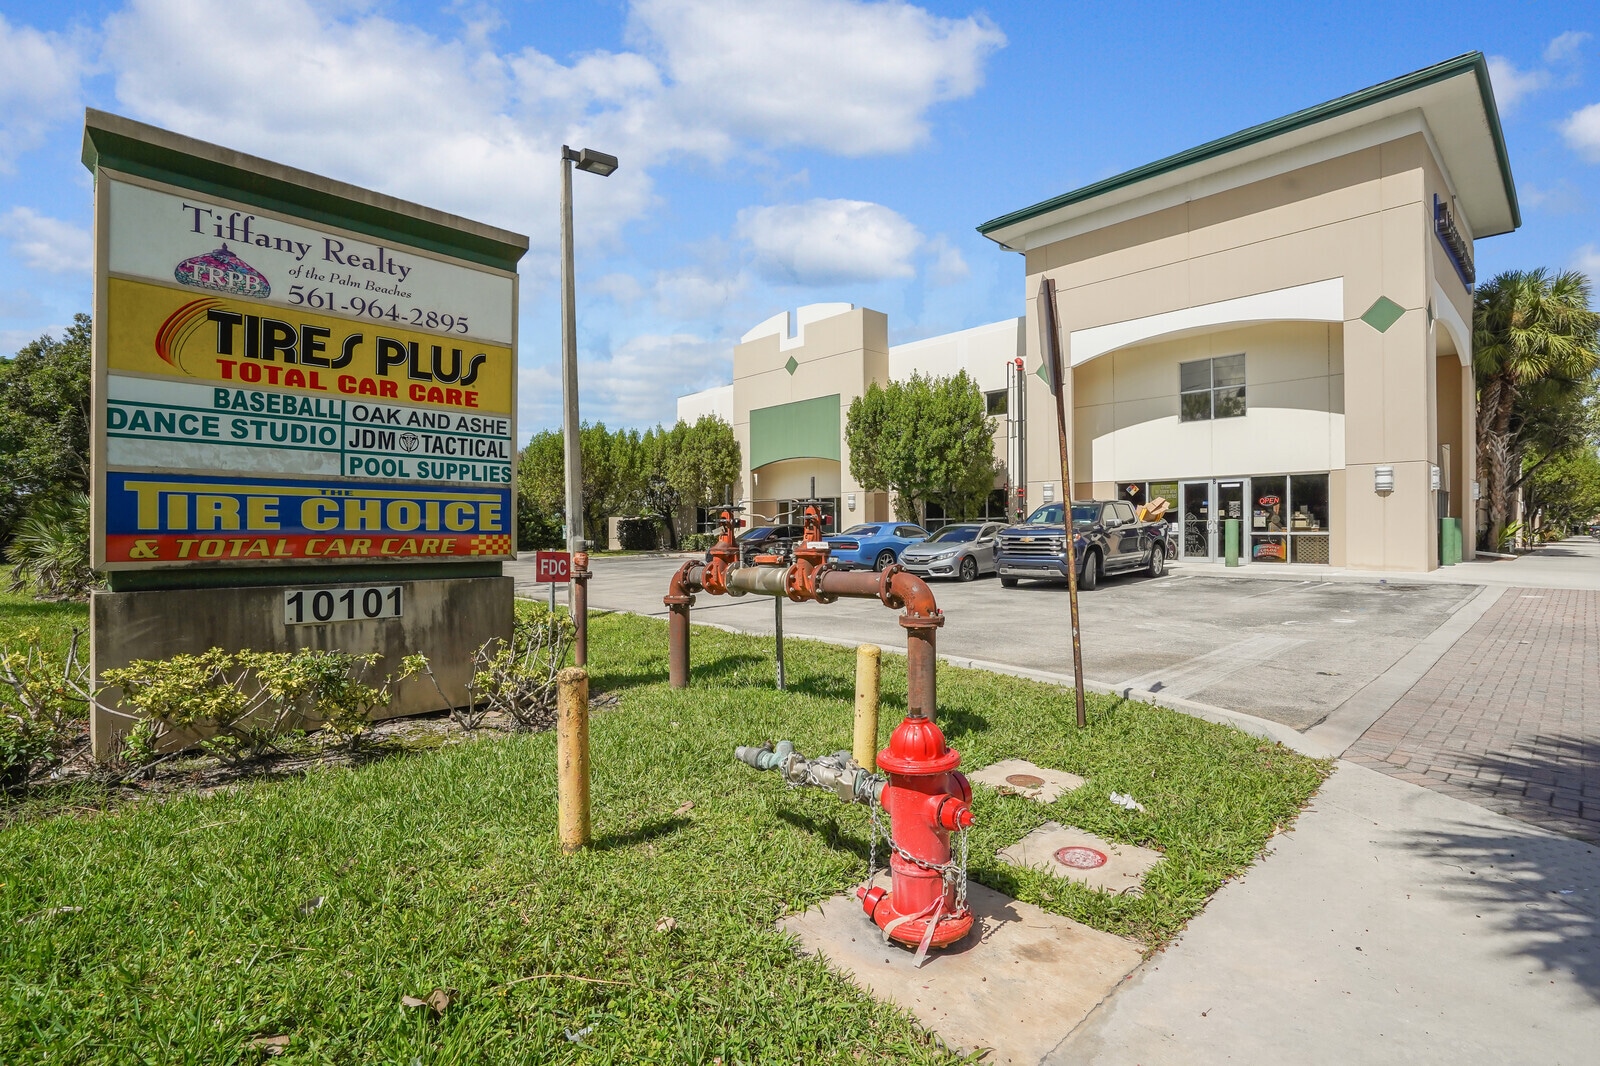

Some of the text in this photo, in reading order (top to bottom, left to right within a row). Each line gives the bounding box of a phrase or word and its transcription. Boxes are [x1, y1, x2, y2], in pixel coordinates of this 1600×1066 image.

[182, 202, 412, 282] Tiffany Realty
[186, 262, 262, 293] TRPB
[288, 265, 412, 299] of the Palm Beaches
[287, 285, 469, 334] 561-964-2895
[207, 308, 486, 386] TIRES PLUS
[216, 358, 479, 408] TOTAL CAR CARE
[213, 387, 341, 420] BASEBALL
[352, 404, 507, 435] OAK AND ASHE
[107, 407, 337, 446] DANCE STUDIO
[349, 428, 508, 459] JDM TACTICAL
[350, 456, 512, 483] POOL SUPPLIES
[123, 480, 503, 532] TIRE CHOICE
[319, 489, 354, 497] THE
[1259, 497, 1280, 505] OPEN
[128, 538, 458, 559] & TOTAL CAR CARE
[540, 558, 567, 576] FDC
[287, 587, 401, 622] 10101
